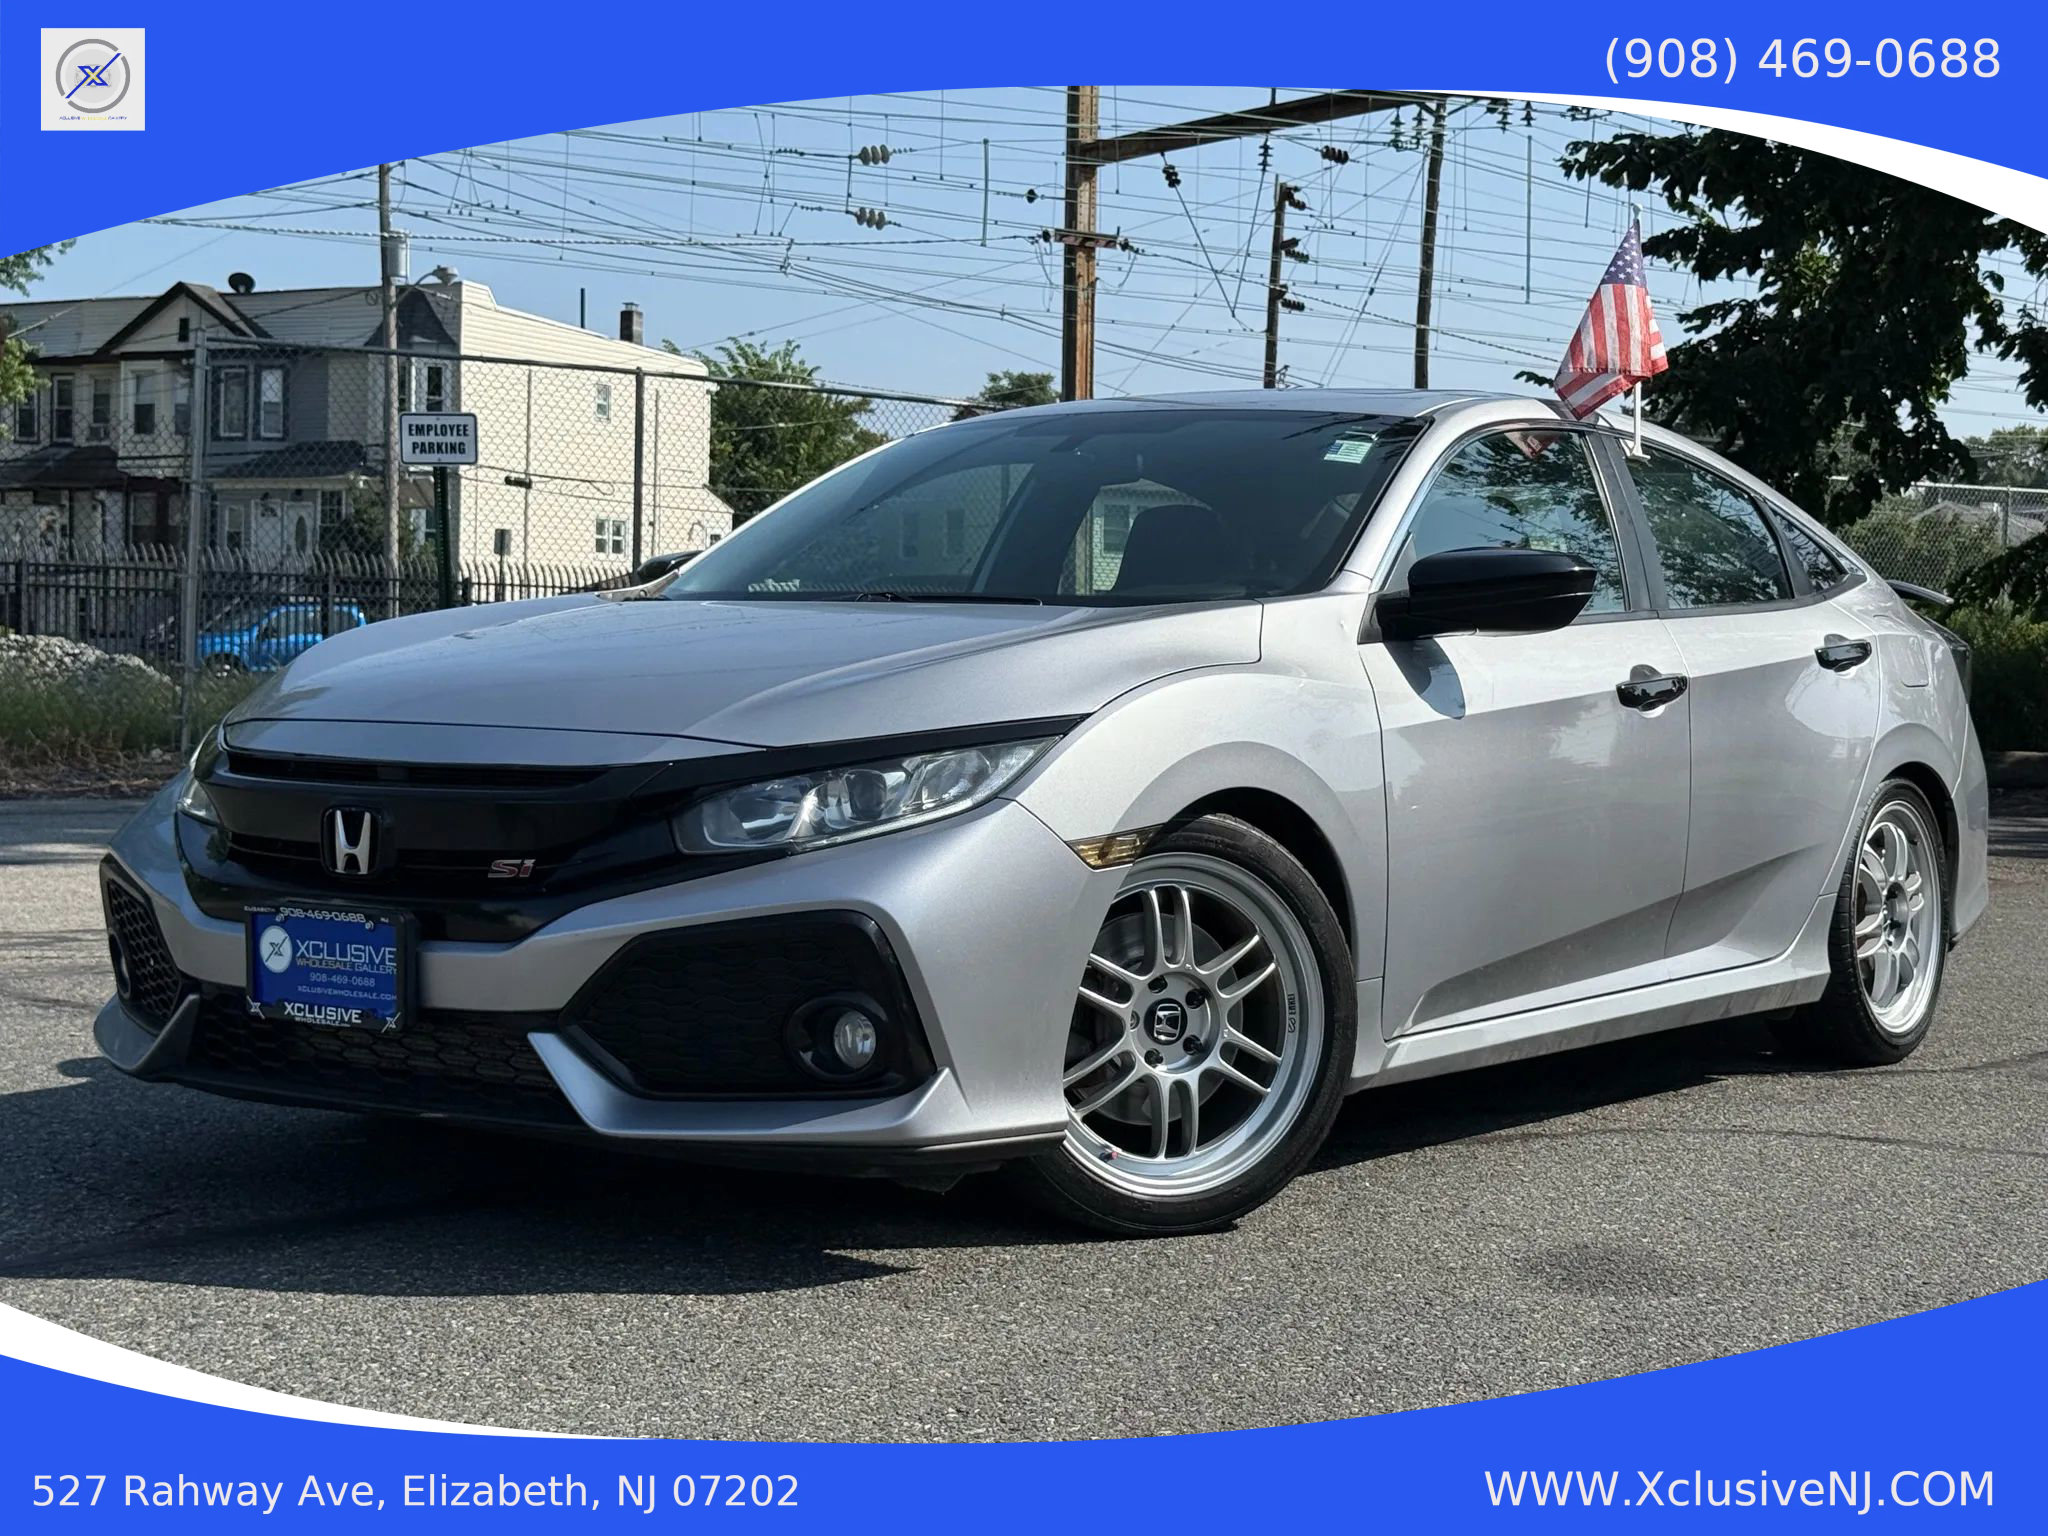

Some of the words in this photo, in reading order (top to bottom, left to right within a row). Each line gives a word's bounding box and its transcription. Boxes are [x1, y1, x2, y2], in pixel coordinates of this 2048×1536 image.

[408, 423, 469, 437] EMPLOYEE
[412, 441, 467, 455] PARKING
[279, 906, 367, 923] 908-469-0688
[296, 939, 397, 966] XCLUSIVE
[296, 958, 353, 972] WHOLESALE
[355, 964, 397, 975] GALLERY
[309, 972, 376, 988] 908-469-0688
[284, 1002, 362, 1023] XCLUSIVE
